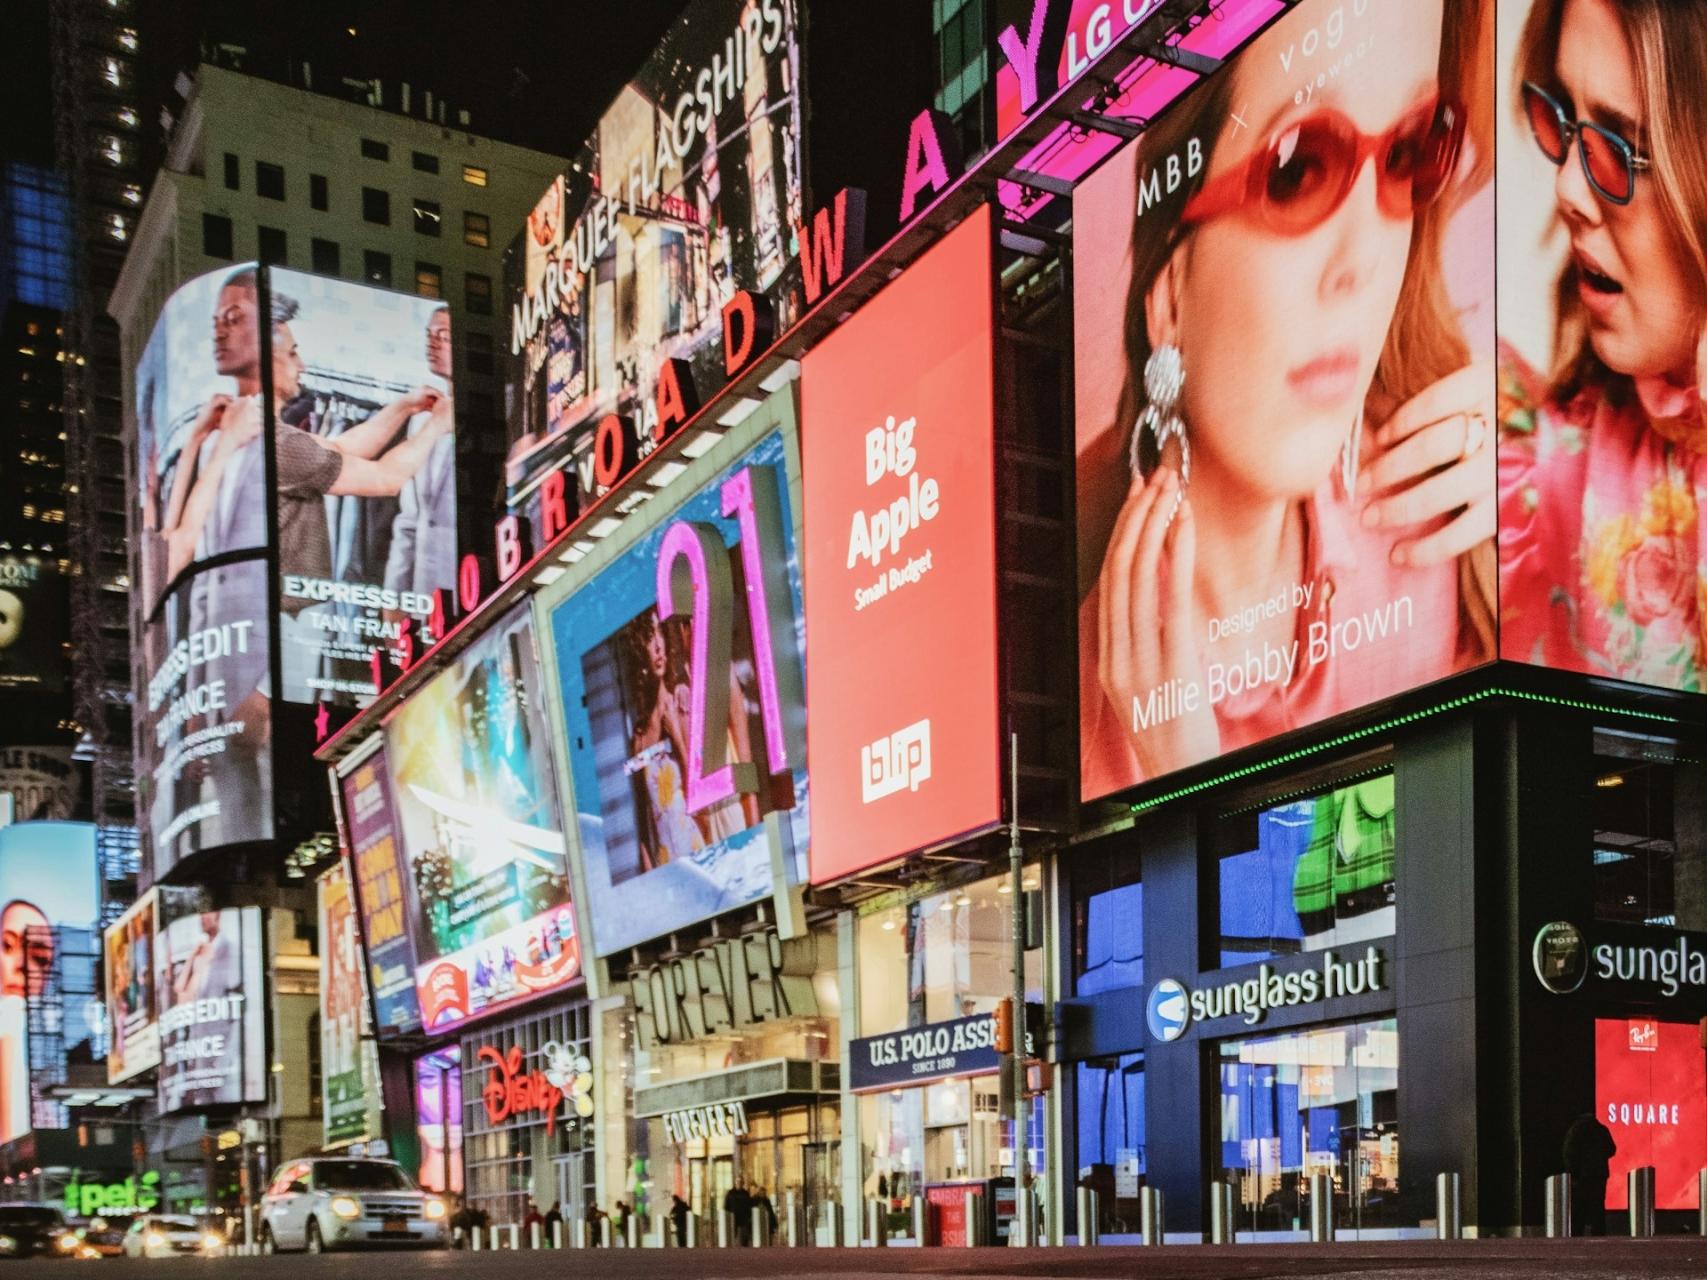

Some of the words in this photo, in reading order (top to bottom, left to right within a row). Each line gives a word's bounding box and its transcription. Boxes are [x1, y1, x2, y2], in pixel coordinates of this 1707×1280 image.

[1067, 3, 1112, 81] LG
[511, 198, 621, 356] MARQUEE
[627, 0, 784, 217] FLAGSHIPS
[1137, 137, 1203, 216] MBB
[495, 0, 1051, 584] BROADWAY
[865, 415, 917, 486] Big
[847, 472, 940, 569] Apple
[282, 575, 399, 611] EXPRESS
[854, 572, 887, 612] Small
[888, 548, 933, 592] Budget
[1208, 589, 1288, 643] Designed
[1292, 581, 1314, 612] by
[189, 620, 254, 666] EDIT
[310, 613, 349, 633] TAN
[656, 465, 790, 815] 21
[1132, 678, 1200, 734] Millie
[1208, 640, 1299, 705] Bobby
[1308, 595, 1414, 666] Brown
[628, 924, 793, 1051] FOREVER
[1190, 963, 1320, 1025] sunglass
[1324, 946, 1380, 998] hut
[869, 1036, 900, 1067] U.S.
[900, 1025, 950, 1062] POLO
[911, 1060, 936, 1075] SINCE
[663, 1102, 730, 1144] FOREVER
[727, 1100, 750, 1136] 21
[1607, 1102, 1679, 1126] SQUARE
